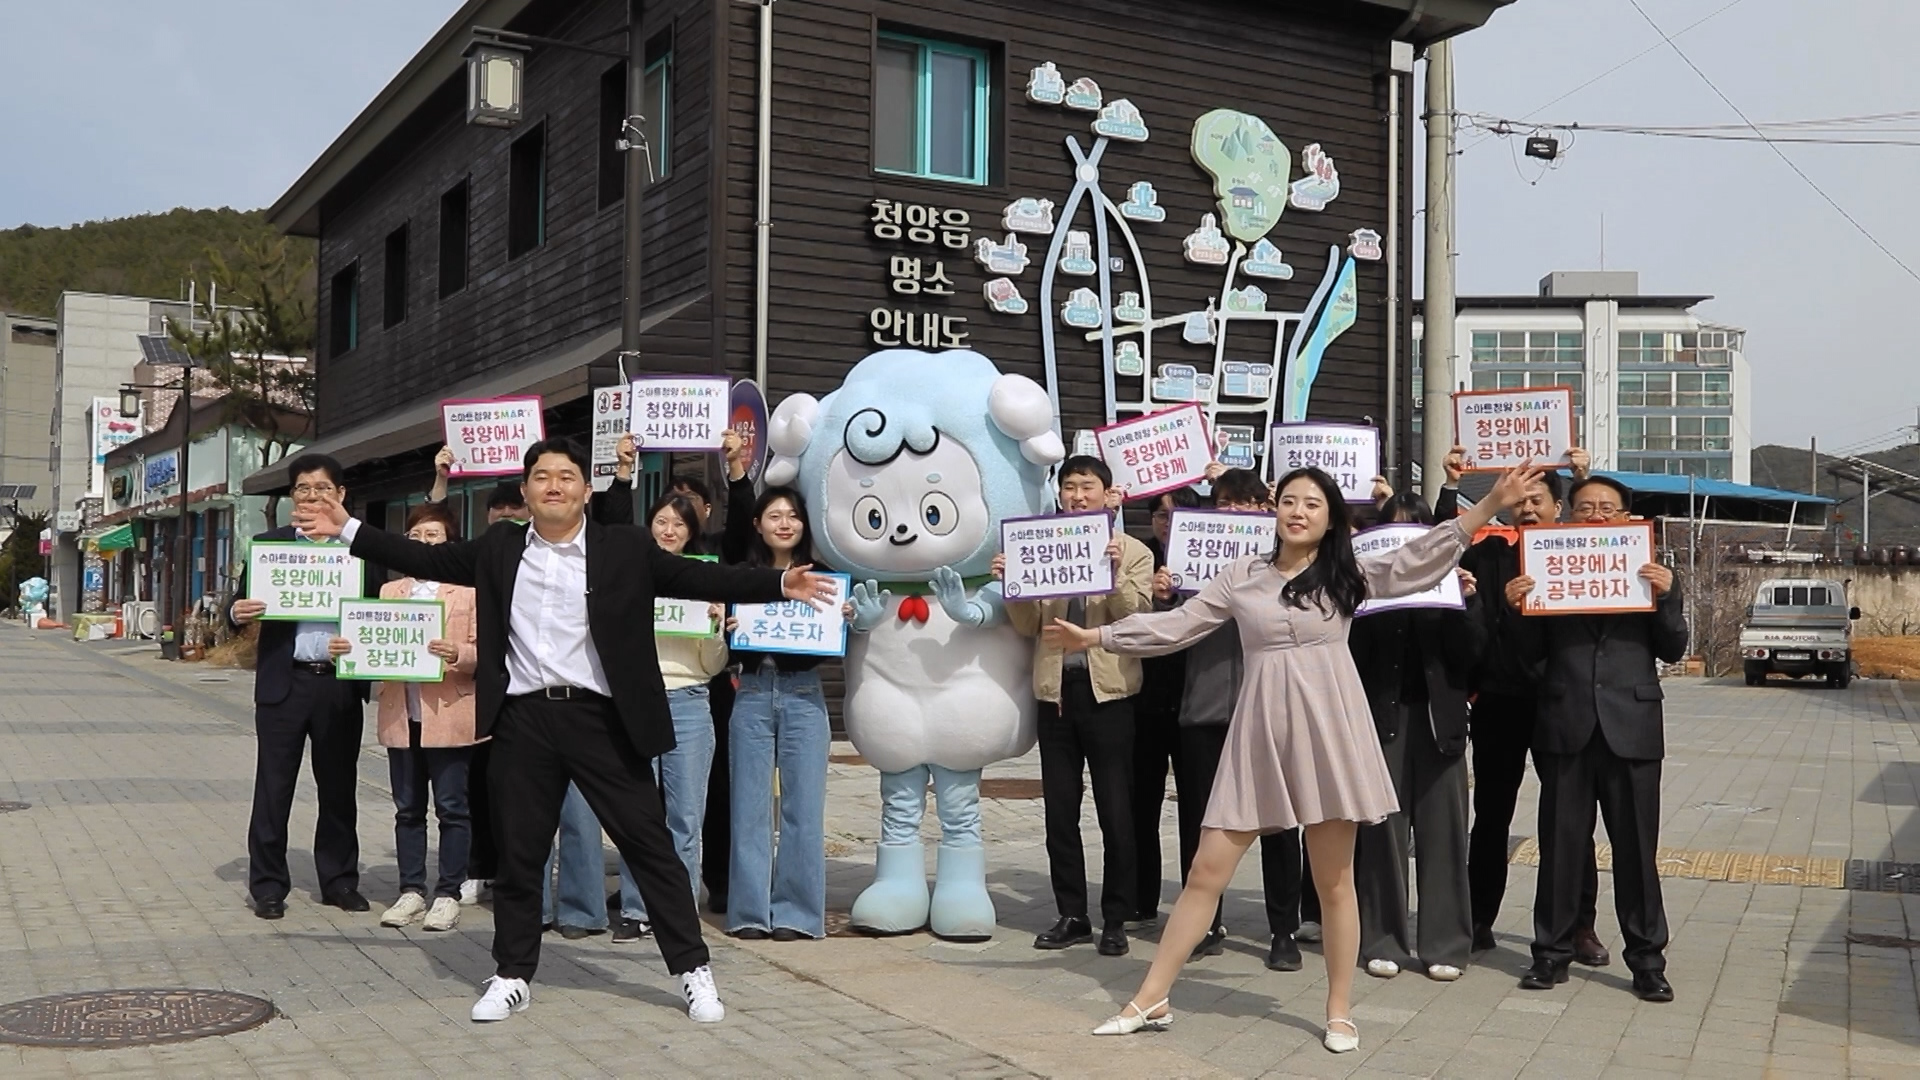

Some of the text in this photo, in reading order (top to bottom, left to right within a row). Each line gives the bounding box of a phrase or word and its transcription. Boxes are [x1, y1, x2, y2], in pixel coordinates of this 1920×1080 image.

[871, 198, 972, 249] 청양읍
[890, 255, 956, 295] 명소
[870, 306, 972, 349] 안내도
[646, 401, 710, 420] 청양에서
[461, 423, 526, 444] 청양에서
[645, 422, 711, 440] 식사하자
[1476, 415, 1549, 438] 청양에서
[471, 445, 520, 464] 다함께
[1122, 433, 1190, 466] 청양에서
[1288, 449, 1357, 468] 청양에서
[1477, 439, 1551, 460] 공부하자
[1136, 456, 1188, 485] 다함께
[1020, 541, 1091, 564] 청양에서
[1187, 537, 1259, 559] 청양에서
[1184, 561, 1221, 582] 식사
[1545, 553, 1628, 576] 청양에서
[271, 567, 342, 587] 청양에서
[1021, 564, 1094, 588] 식사하자
[279, 591, 333, 608] 장보자
[1546, 578, 1630, 600] 공부하자
[655, 605, 685, 623] 보자
[358, 625, 424, 645] 청양에서
[753, 619, 823, 641] 주소두자
[367, 649, 417, 668] 장보자
